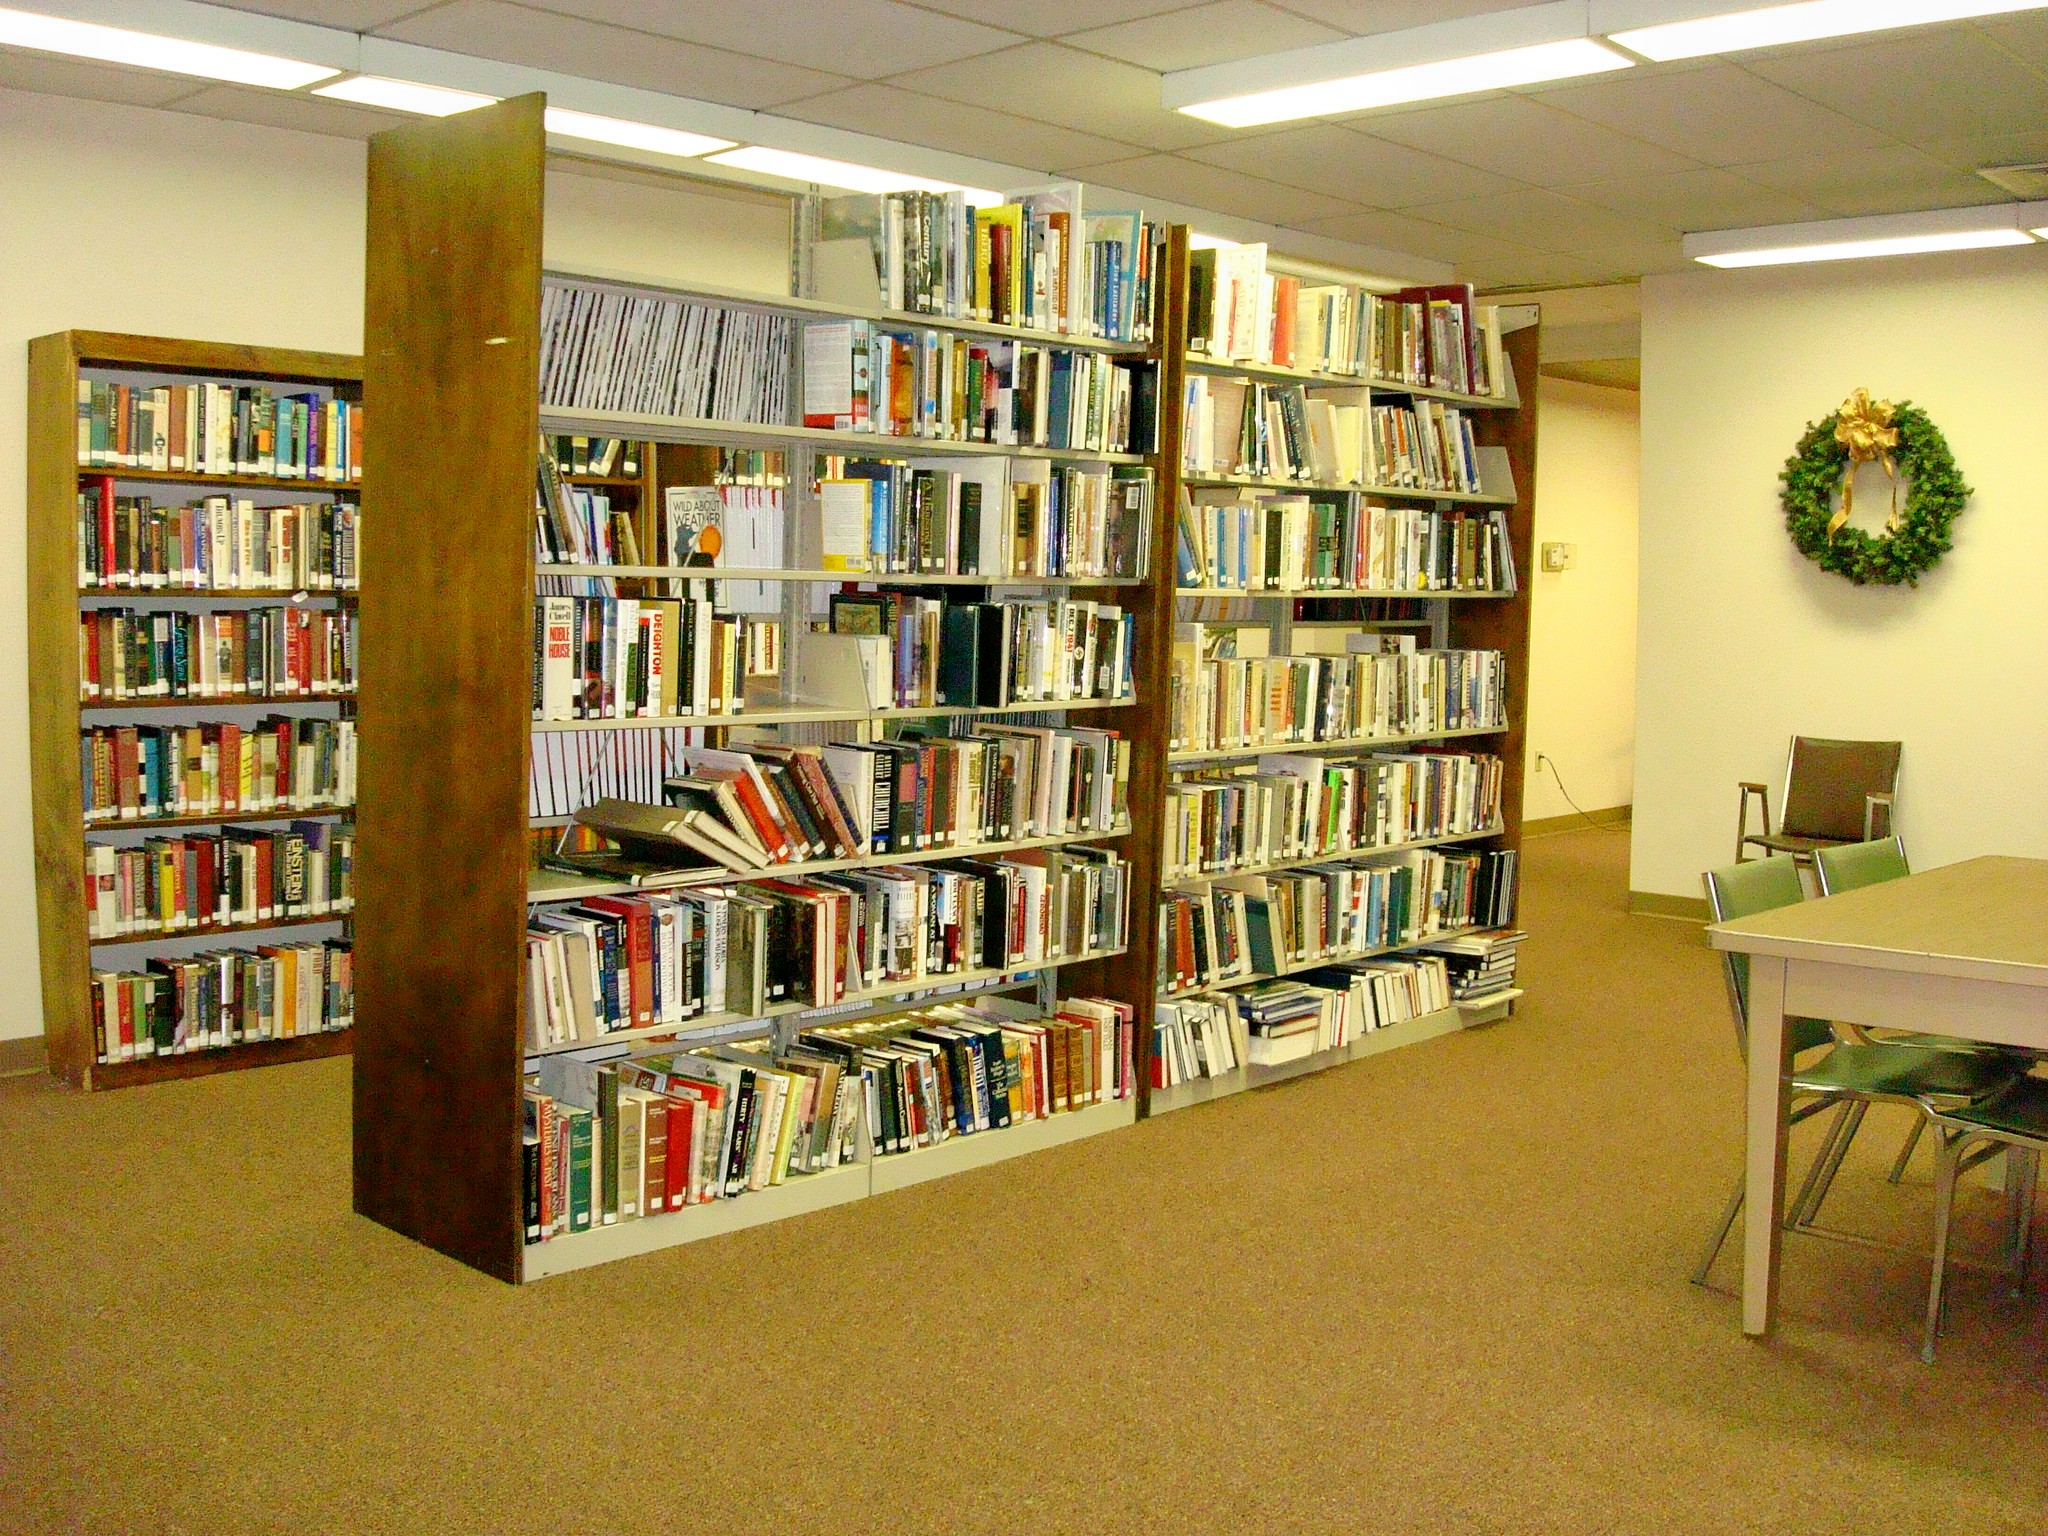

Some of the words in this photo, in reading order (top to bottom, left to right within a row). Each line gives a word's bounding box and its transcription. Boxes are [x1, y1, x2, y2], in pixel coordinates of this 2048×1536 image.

[923, 215, 931, 266] Century
[672, 500, 693, 511] WILD
[694, 499, 721, 511] ABOUT
[216, 505, 225, 534] THUMBS
[673, 513, 721, 527] WEATHER
[216, 535, 226, 545] UP
[548, 601, 572, 613] James
[549, 626, 571, 641] NOBLE
[549, 643, 571, 659] HOUSE
[653, 614, 663, 675] DEIGHTON
[873, 782, 891, 831] CHURCHILL
[291, 839, 303, 894] EINSTEIN
[930, 929, 935, 939] AT
[668, 955, 674, 966] OF
[739, 1093, 752, 1123] THIRTY
[544, 1103, 552, 1155] MYSTERIES
[731, 1154, 741, 1174] WAR
[544, 1167, 552, 1188] PAST
